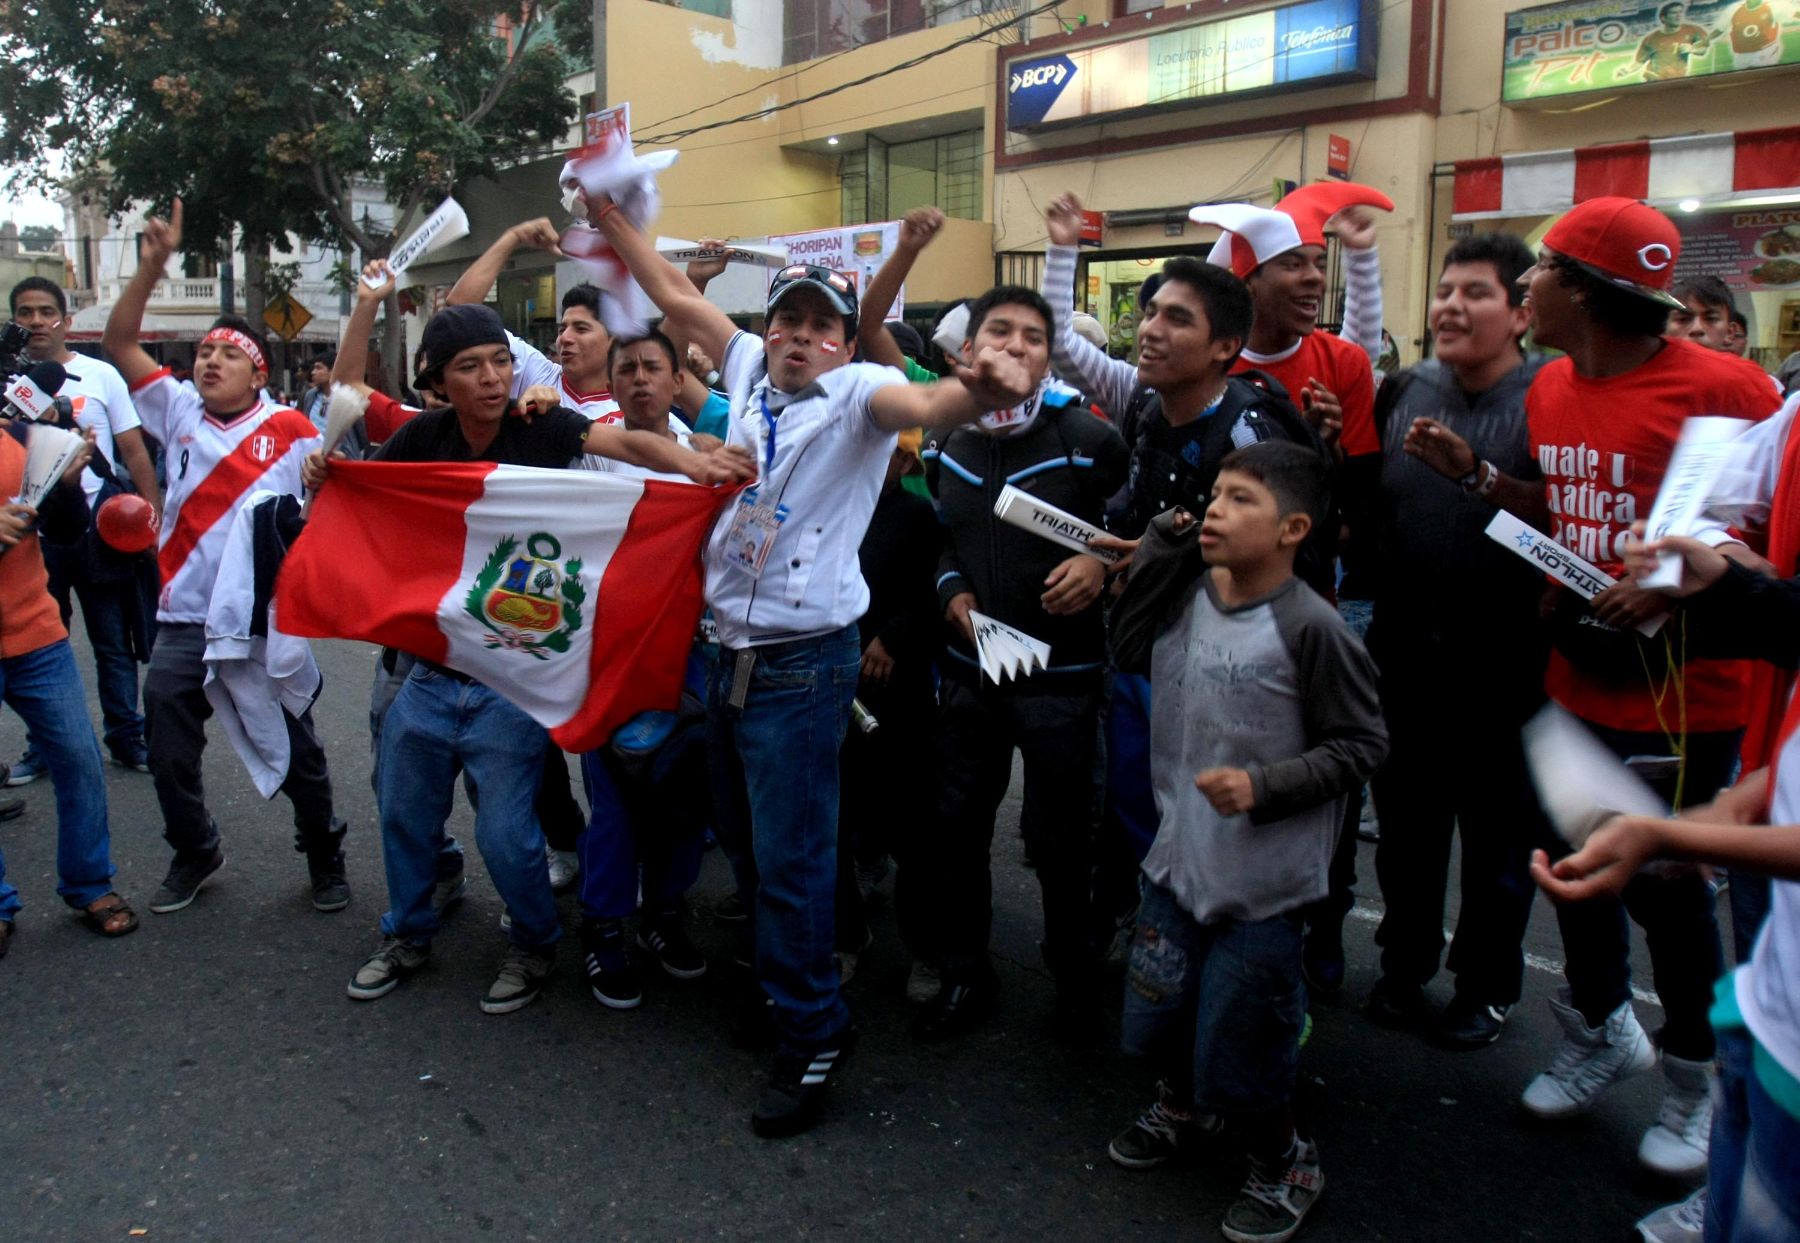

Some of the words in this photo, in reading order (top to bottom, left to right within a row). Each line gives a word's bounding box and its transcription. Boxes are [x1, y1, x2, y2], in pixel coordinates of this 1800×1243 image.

[1021, 65, 1056, 88] BCP
[673, 249, 754, 261] TRIATHON
[1637, 243, 1672, 271] C
[178, 448, 190, 481] 9
[1538, 442, 1599, 480] mate
[1537, 539, 1571, 564] SPORT
[1529, 544, 1606, 596] ATHLON
